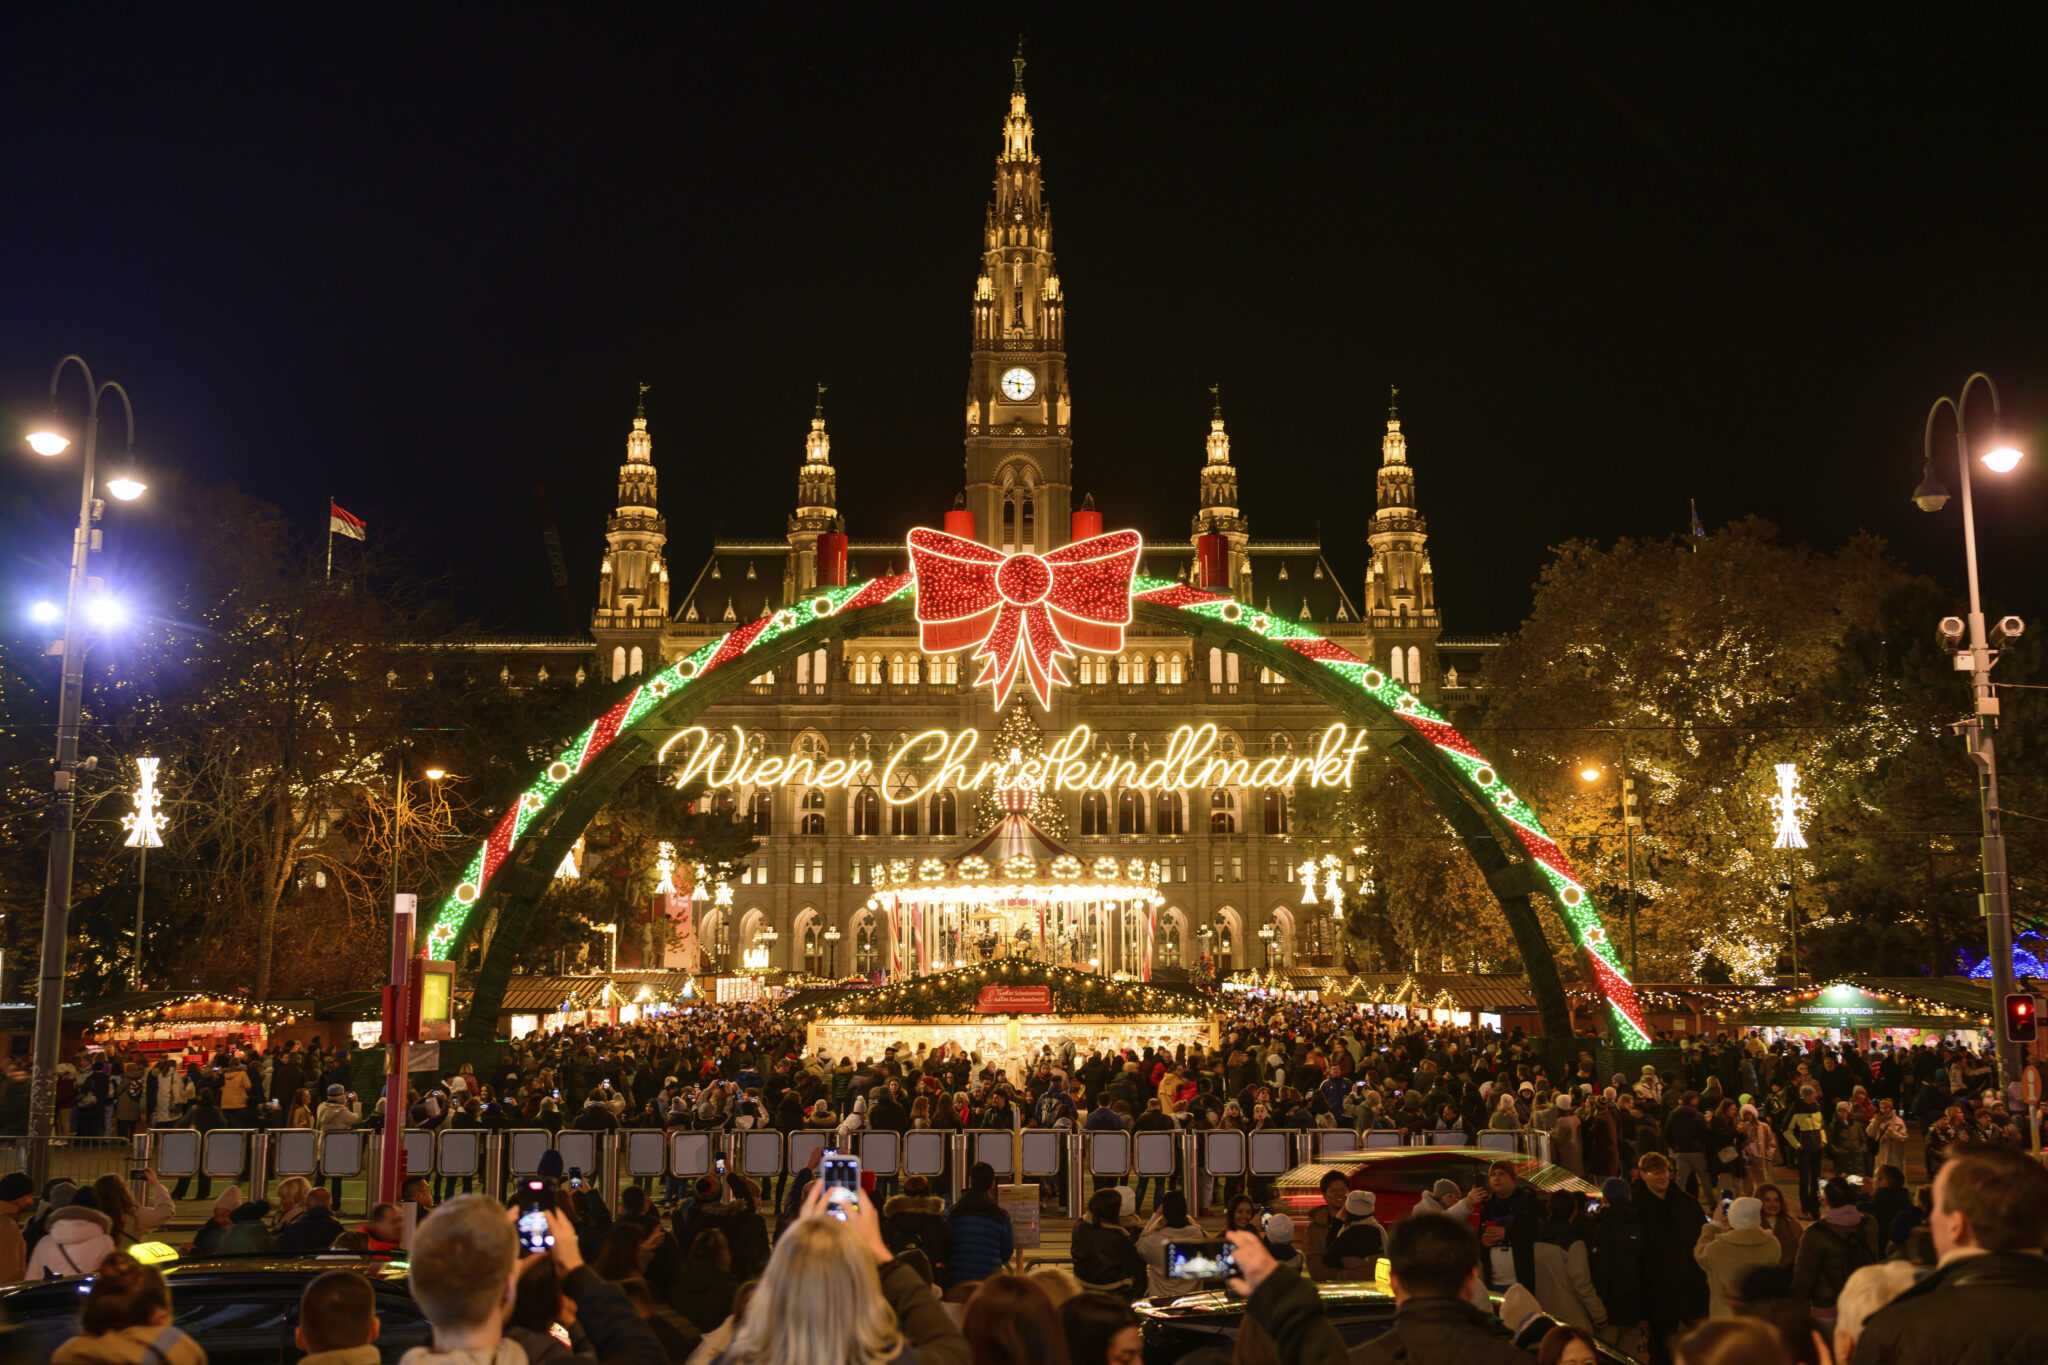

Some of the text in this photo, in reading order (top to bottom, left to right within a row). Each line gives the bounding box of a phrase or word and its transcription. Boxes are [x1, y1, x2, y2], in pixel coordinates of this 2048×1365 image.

[658, 722, 1370, 805] Wiener Christkindlmarkt
[1799, 1005, 1840, 1015] GLÜHWEIN
[1841, 1007, 1874, 1015] PUNSCH
